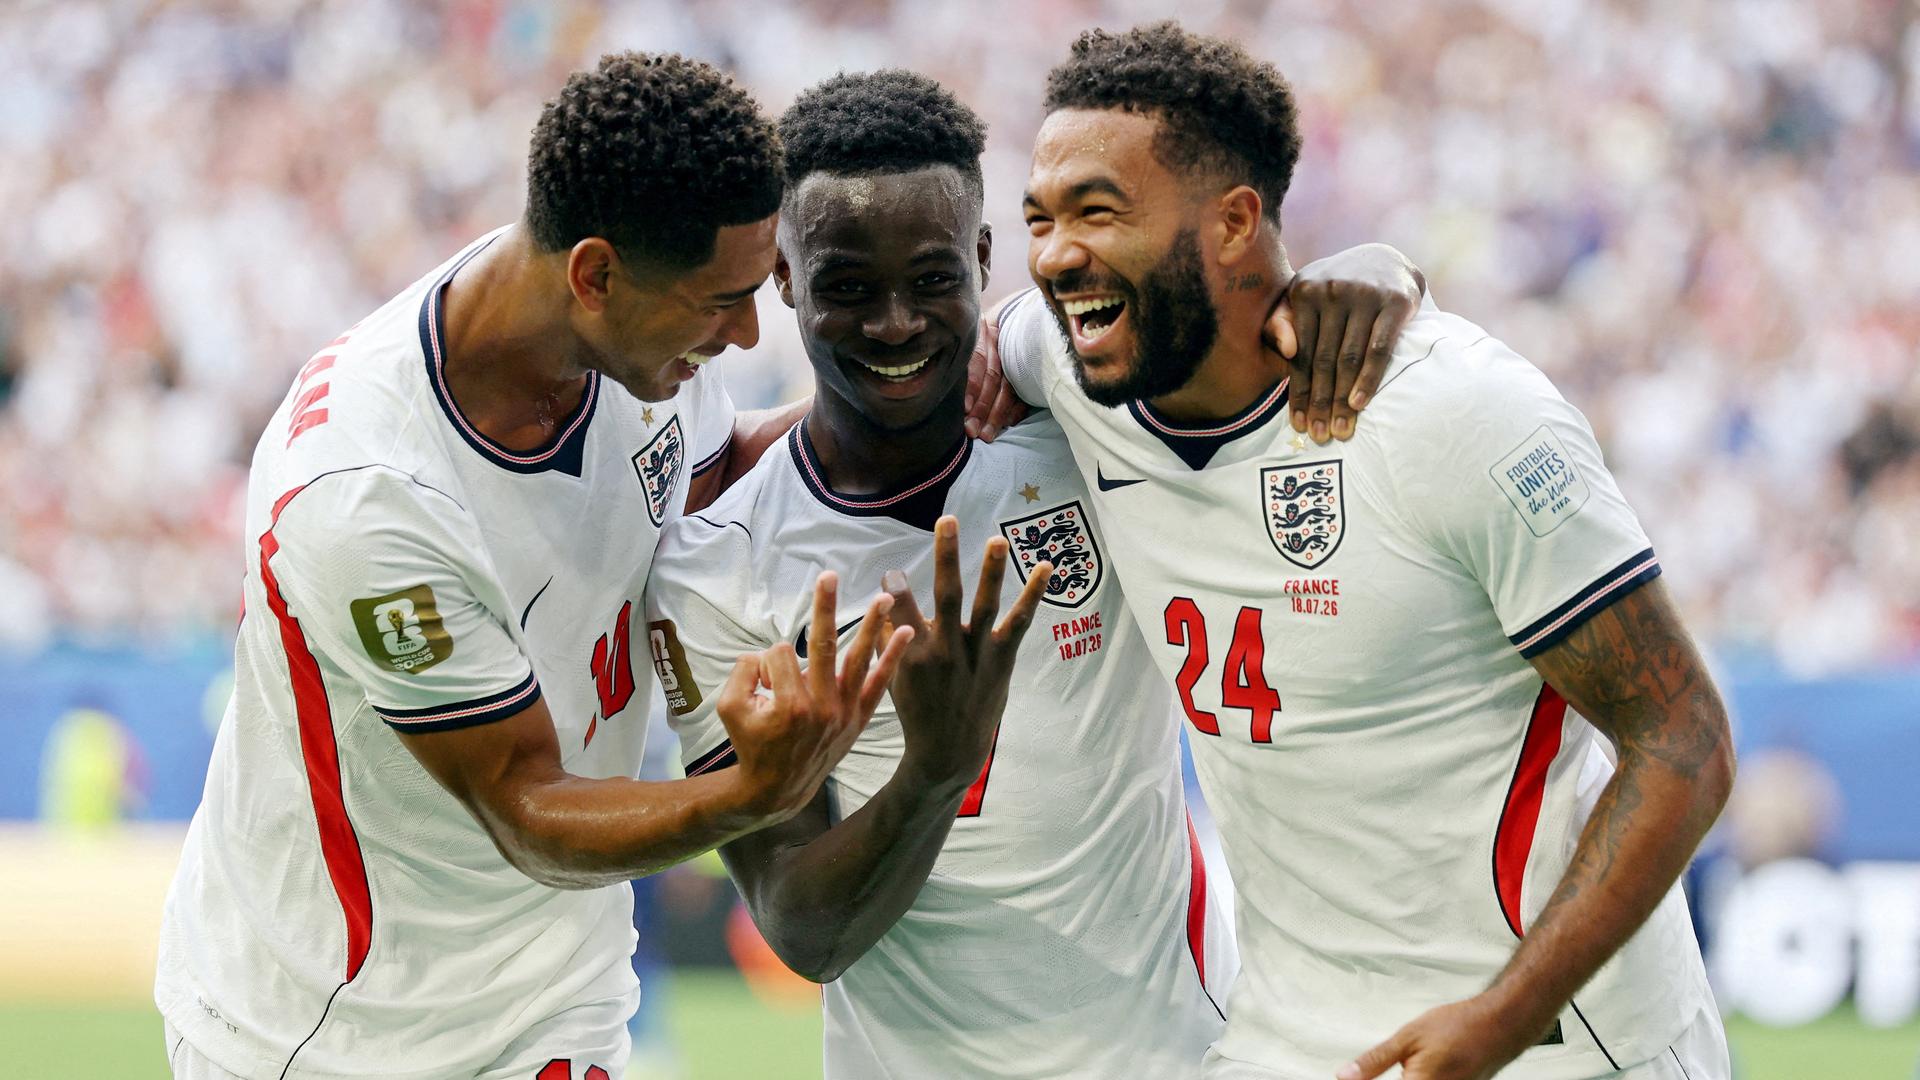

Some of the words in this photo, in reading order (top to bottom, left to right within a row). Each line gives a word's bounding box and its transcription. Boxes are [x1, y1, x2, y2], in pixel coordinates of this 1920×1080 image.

[1506, 441, 1553, 483] FOOTBALL
[1516, 452, 1565, 498] UNITES
[1526, 498, 1548, 515] the
[1546, 467, 1576, 501] World
[1551, 496, 1571, 514] FIFA
[1284, 580, 1339, 596] FRANCE
[1291, 596, 1338, 616] 18.07.26
[1052, 611, 1102, 642] FRANCE
[397, 642, 416, 651] FIFA
[417, 647, 431, 657] CUP
[1059, 633, 1102, 661] 18.07.26
[393, 653, 435, 671] 2026
[1164, 596, 1282, 744] 24
